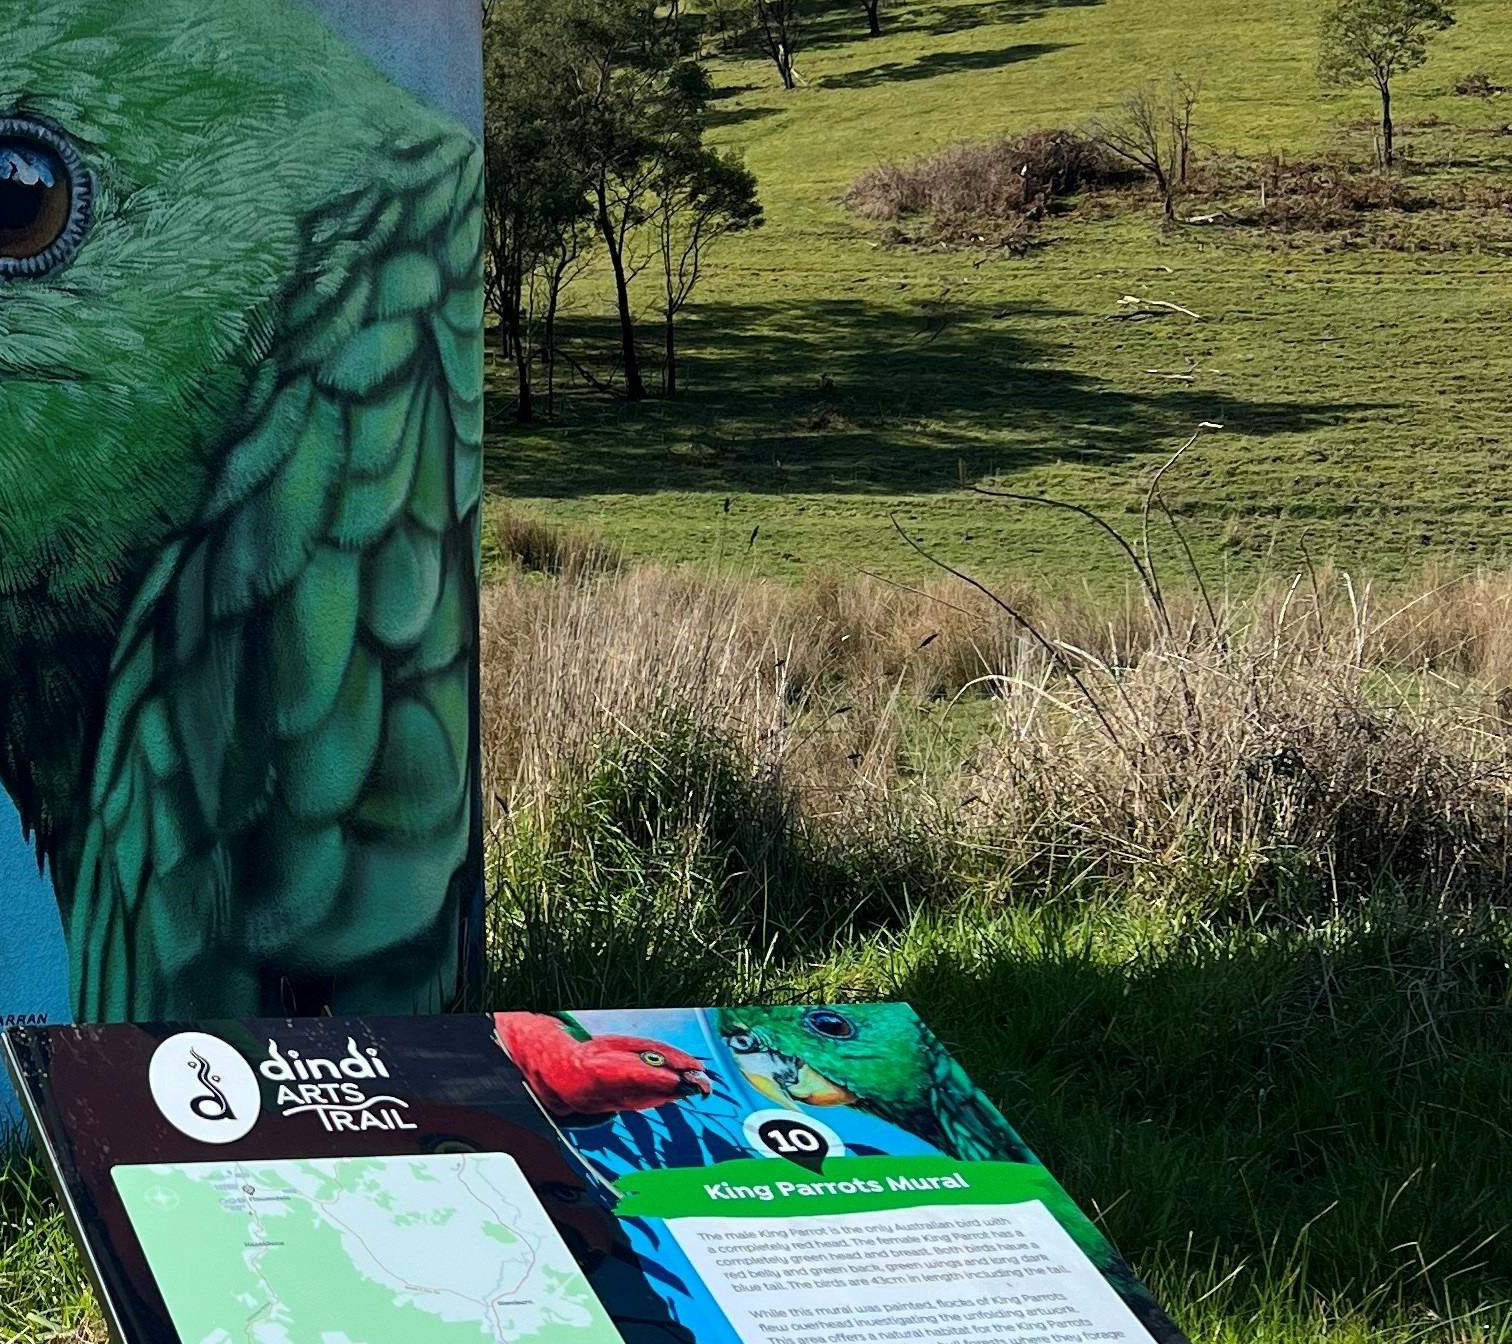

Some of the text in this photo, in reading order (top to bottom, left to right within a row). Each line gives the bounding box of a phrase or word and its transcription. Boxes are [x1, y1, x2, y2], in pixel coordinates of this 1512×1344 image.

[259, 1037, 390, 1081] dindi
[277, 1082, 366, 1105] ARTS
[315, 1106, 419, 1132] TRAIL
[766, 1127, 820, 1153] 10
[703, 1172, 970, 1201] King Parrots Mural
[748, 1308, 787, 1318] While
[788, 1307, 814, 1317] this
[815, 1304, 853, 1315] mural
[855, 1304, 882, 1313] was
[883, 1300, 938, 1312] painted,
[936, 1298, 975, 1307] flocks
[991, 1295, 1022, 1304] King
[1021, 1292, 1067, 1302] Parrots
[759, 1305, 1080, 1332] flew overhead investigating the unfolding artwork.
[767, 1335, 796, 1344] This
[797, 1336, 827, 1344] area
[828, 1332, 866, 1342] offers
[878, 1328, 925, 1339] natural
[924, 1325, 972, 1336] habitat
[972, 1324, 991, 1333] for
[992, 1323, 1015, 1332] the
[1016, 1321, 1047, 1331] King
[1046, 1318, 1093, 1328] Parrots
[1009, 1335, 1050, 1344] where
[1051, 1334, 1082, 1342] they
[1082, 1330, 1125, 1340] forage
